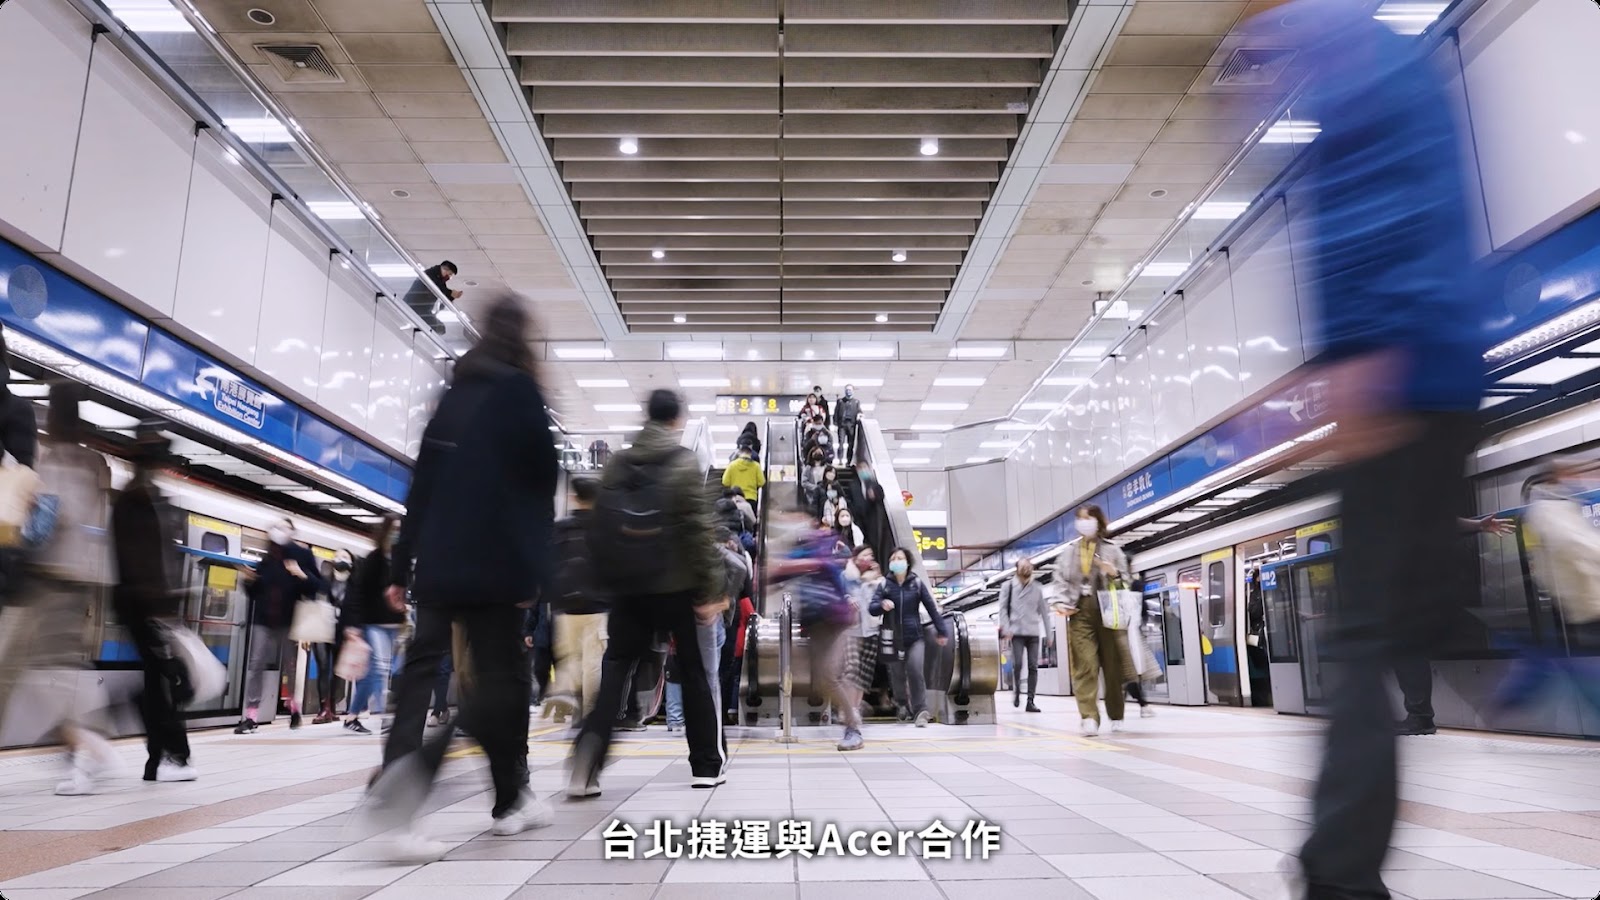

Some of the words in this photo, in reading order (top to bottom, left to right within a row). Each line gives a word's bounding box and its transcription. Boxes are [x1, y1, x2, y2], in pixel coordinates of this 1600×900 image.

[217, 400, 243, 419] Exhibition
[243, 413, 261, 427] Center
[1269, 571, 1277, 586] 2
